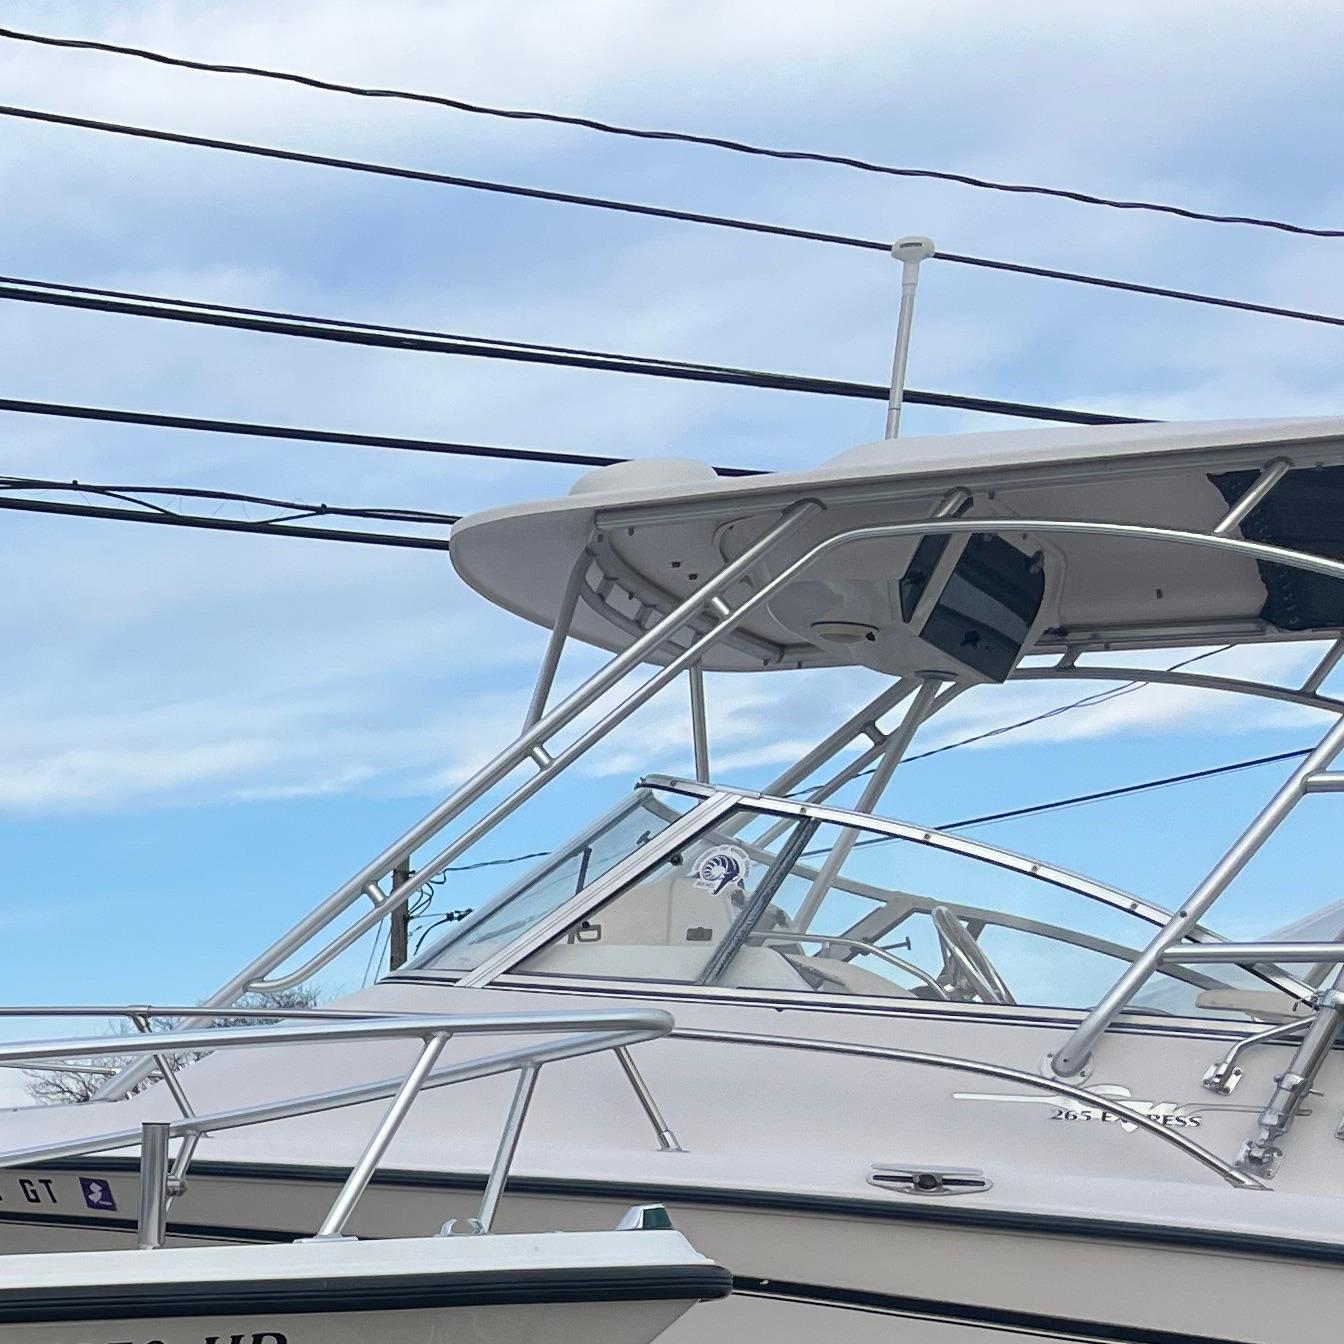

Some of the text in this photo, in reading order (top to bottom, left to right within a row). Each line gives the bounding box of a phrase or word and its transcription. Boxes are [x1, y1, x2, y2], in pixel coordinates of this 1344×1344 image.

[1051, 1109, 1202, 1128] 265 ERESS
[18, 1179, 58, 1203] GT
